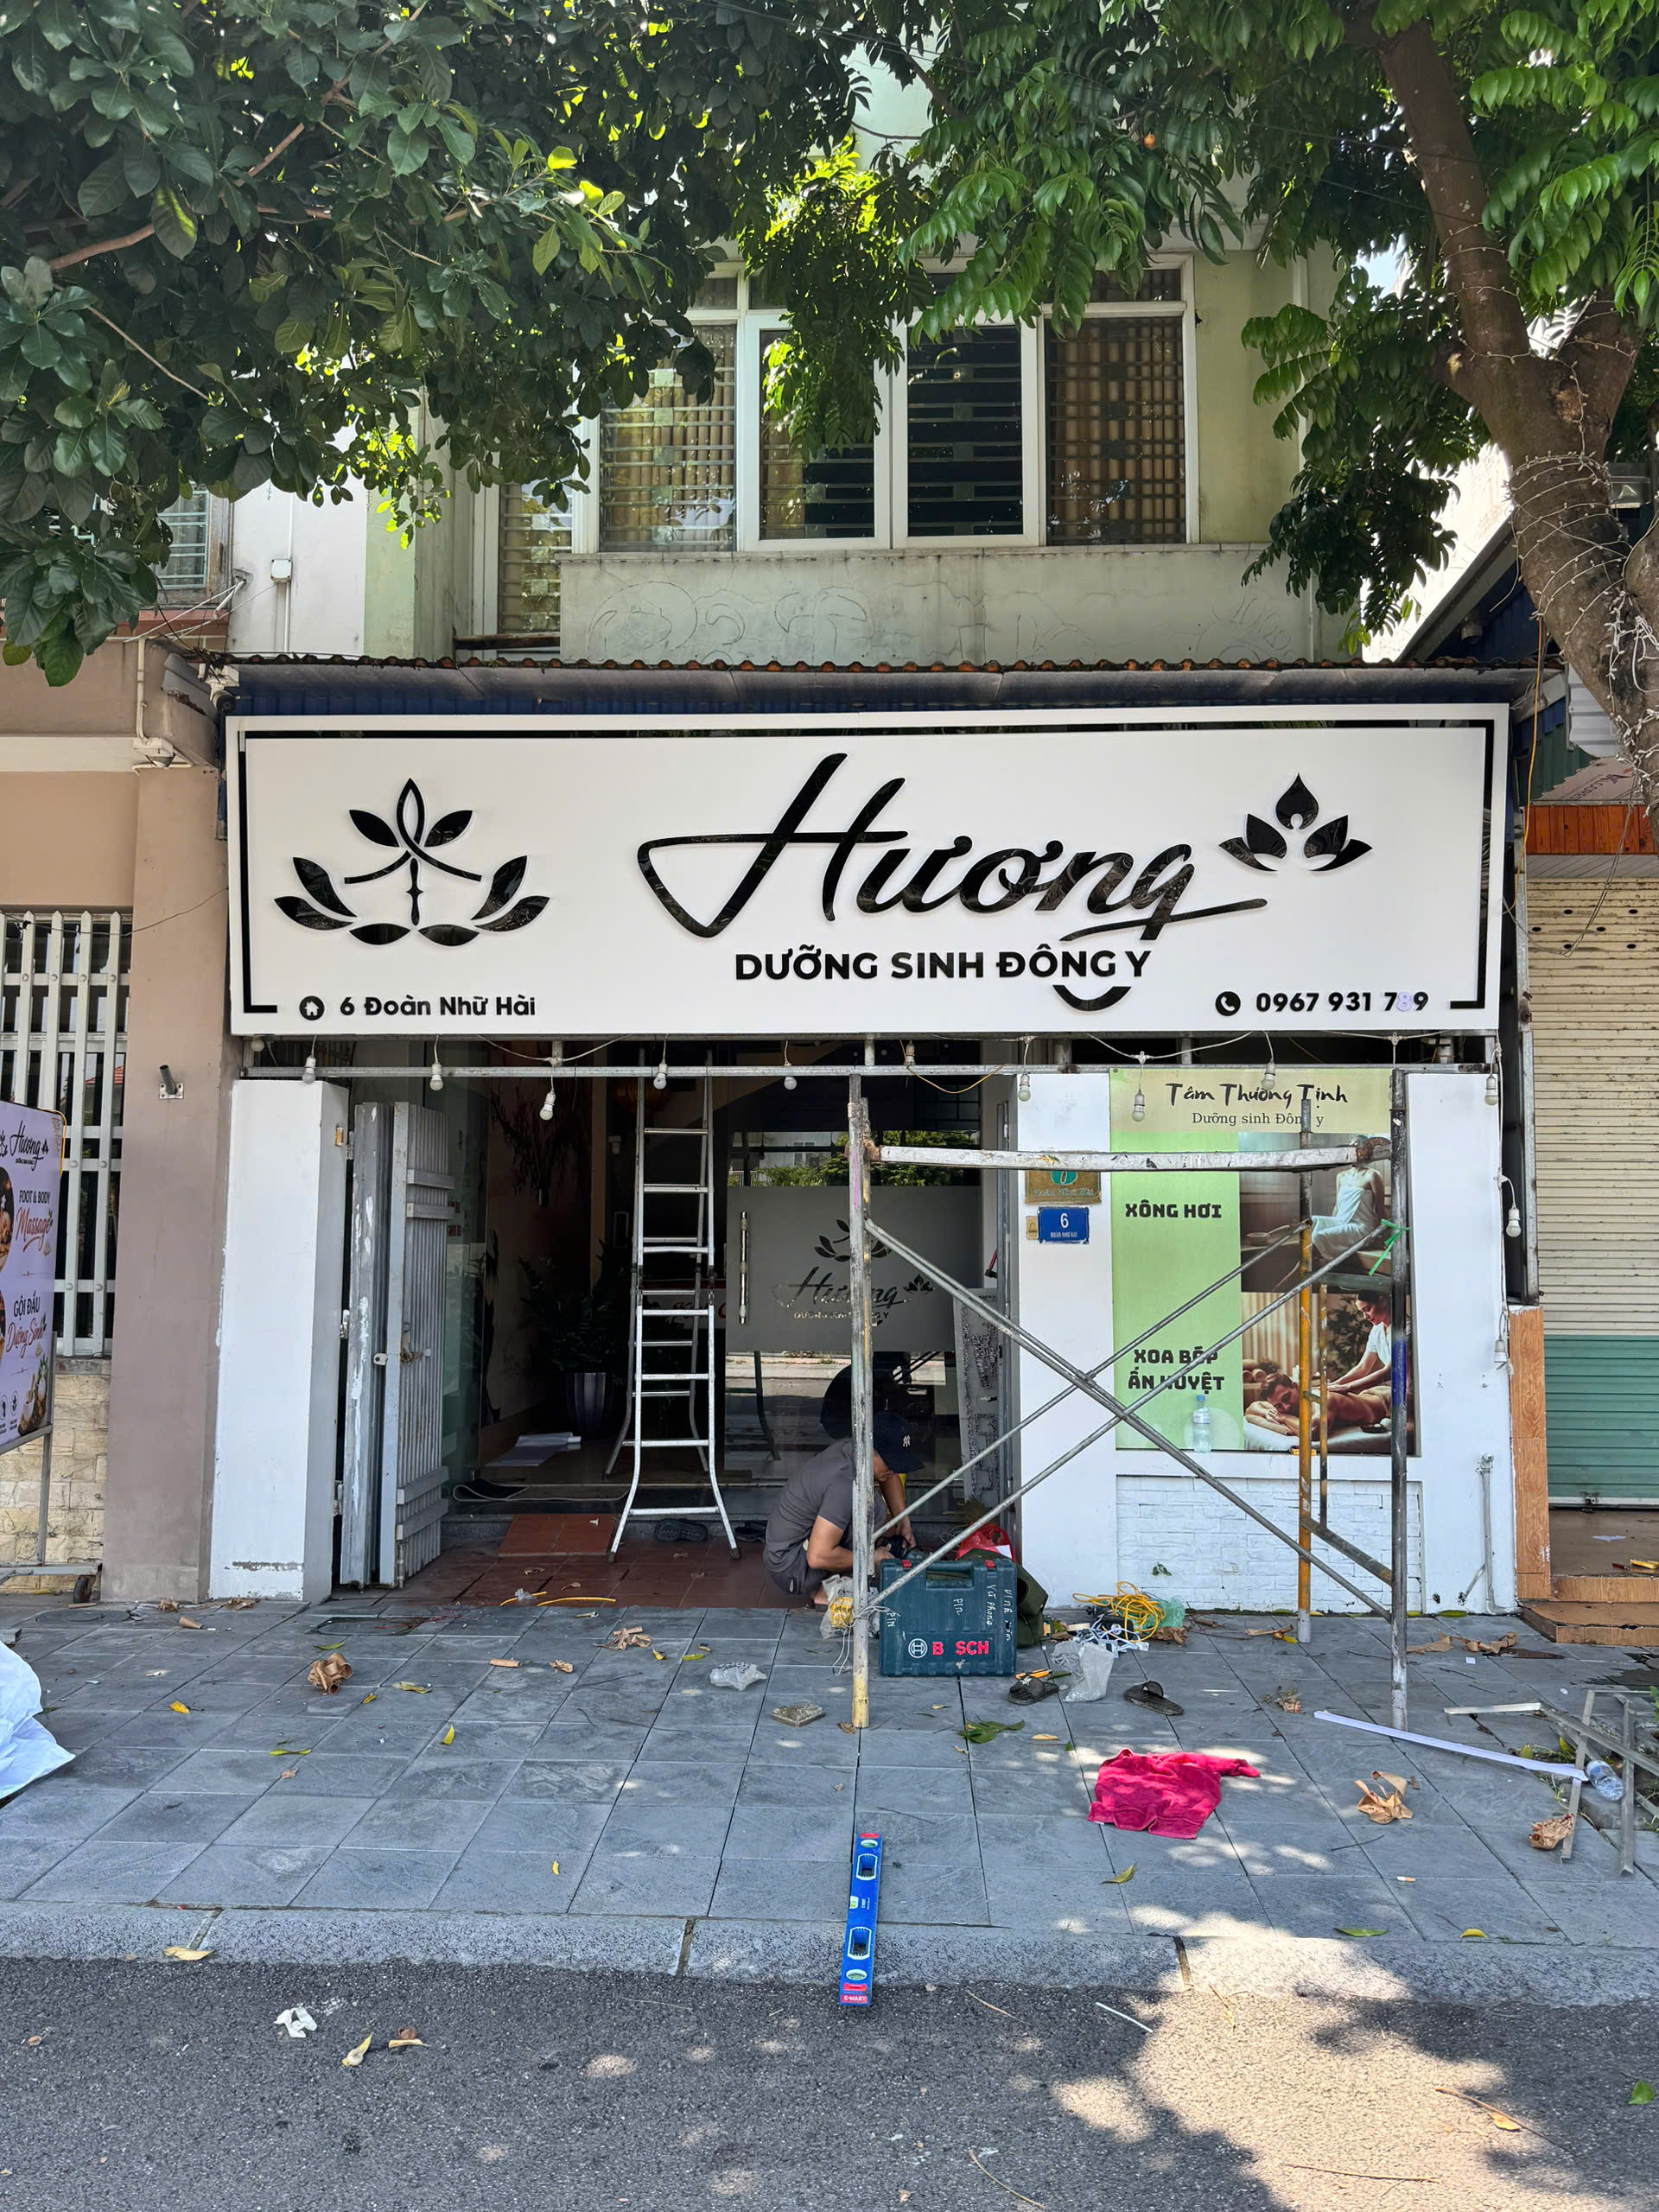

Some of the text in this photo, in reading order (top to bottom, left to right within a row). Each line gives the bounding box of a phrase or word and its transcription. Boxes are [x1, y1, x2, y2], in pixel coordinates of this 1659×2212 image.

[638, 753, 1268, 942] Hương
[736, 943, 1152, 981] DƯỠNG SINH ĐÔNG Y
[340, 995, 536, 1016] 6 Đoàn Nhữ Hài
[1255, 991, 1429, 1013] 0967 931 789
[1165, 1083, 1215, 1107] Tâm
[1297, 1084, 1348, 1109] Tịnh
[1192, 1111, 1324, 1127] Dưỡng sinh Đôn y
[19, 1190, 50, 1204] FOOT & BODY
[1125, 1199, 1222, 1218] XÔNG HƠI
[16, 1207, 50, 1252] Massage
[1060, 1212, 1069, 1229] 6
[14, 1295, 27, 1320] GỘI
[1134, 1350, 1173, 1363] XOA
[1128, 1367, 1154, 1389] ẤN
